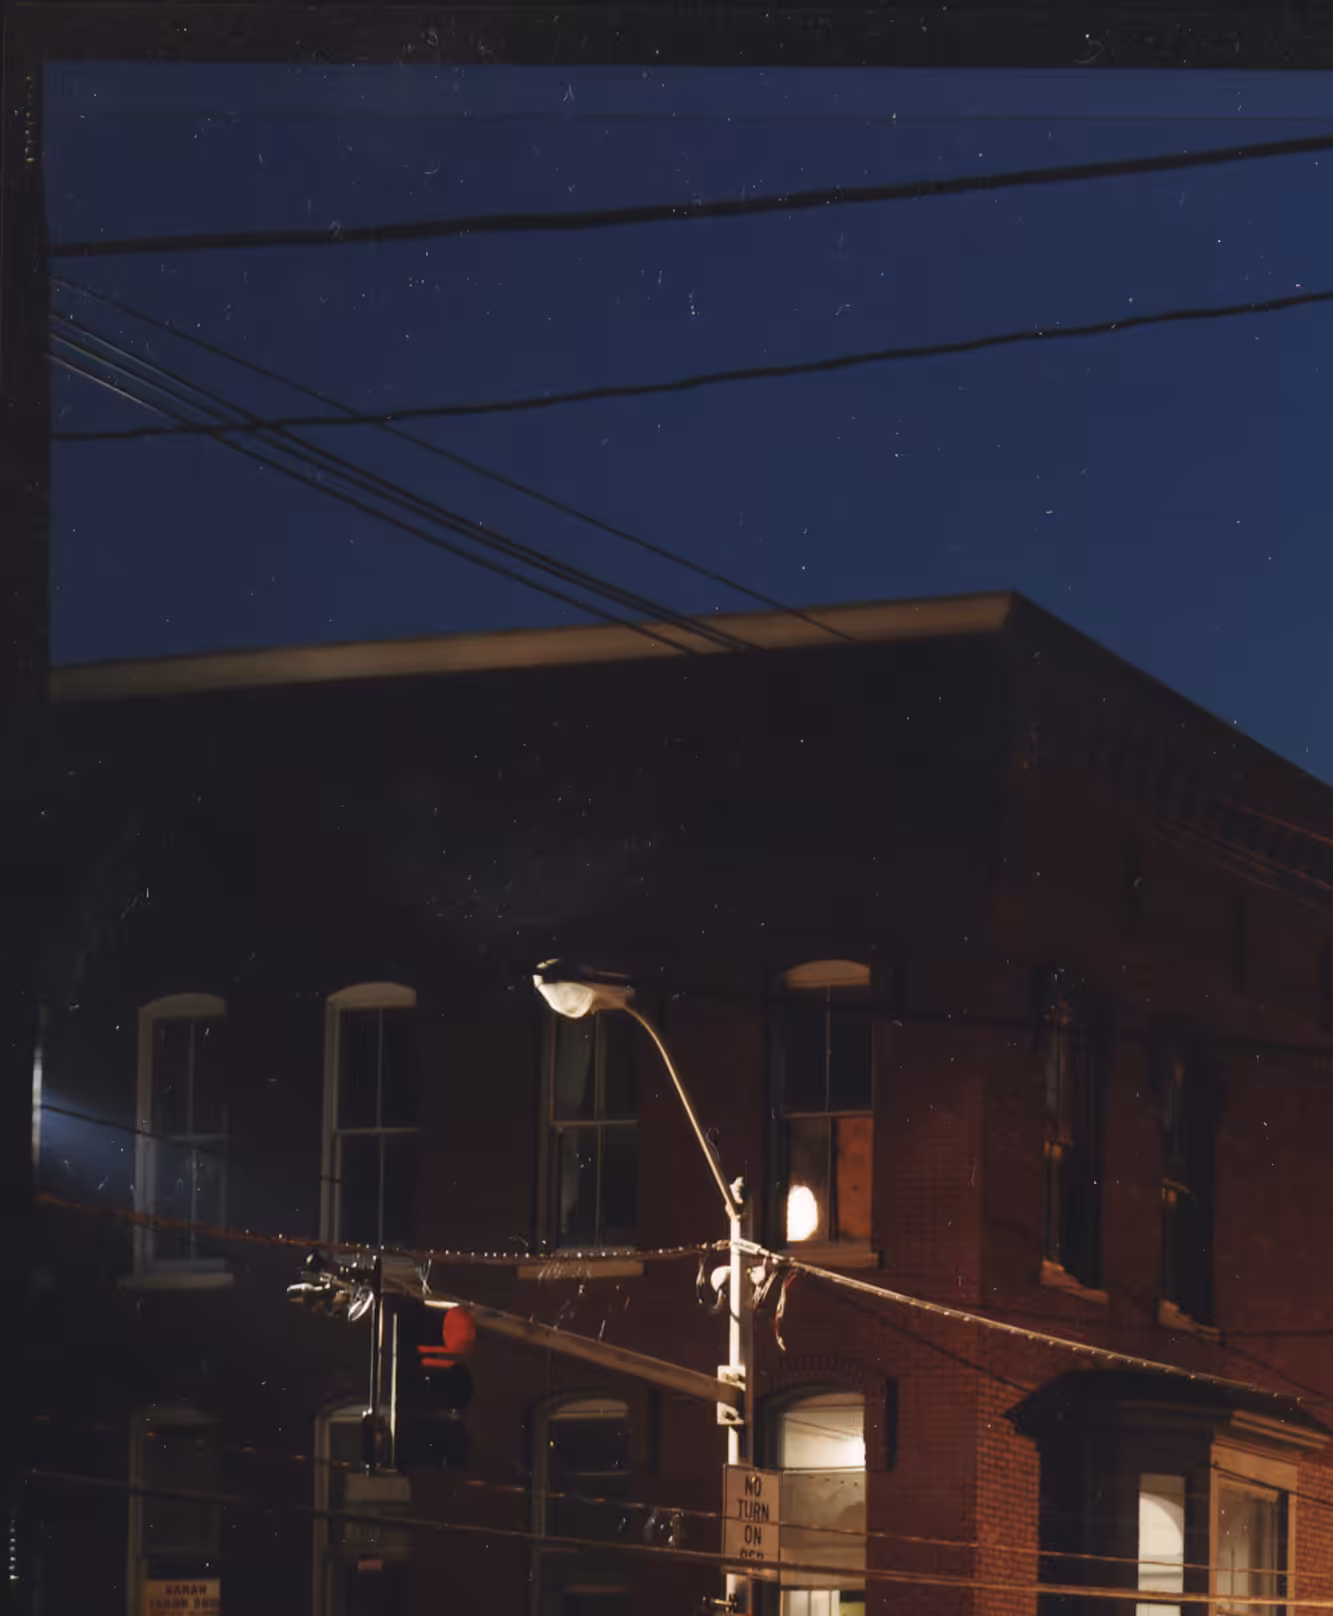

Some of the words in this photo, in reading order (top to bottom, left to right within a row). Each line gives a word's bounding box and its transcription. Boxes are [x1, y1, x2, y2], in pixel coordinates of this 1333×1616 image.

[744, 1475, 762, 1497] NO
[737, 1498, 770, 1521] TURN
[744, 1524, 762, 1545] ON
